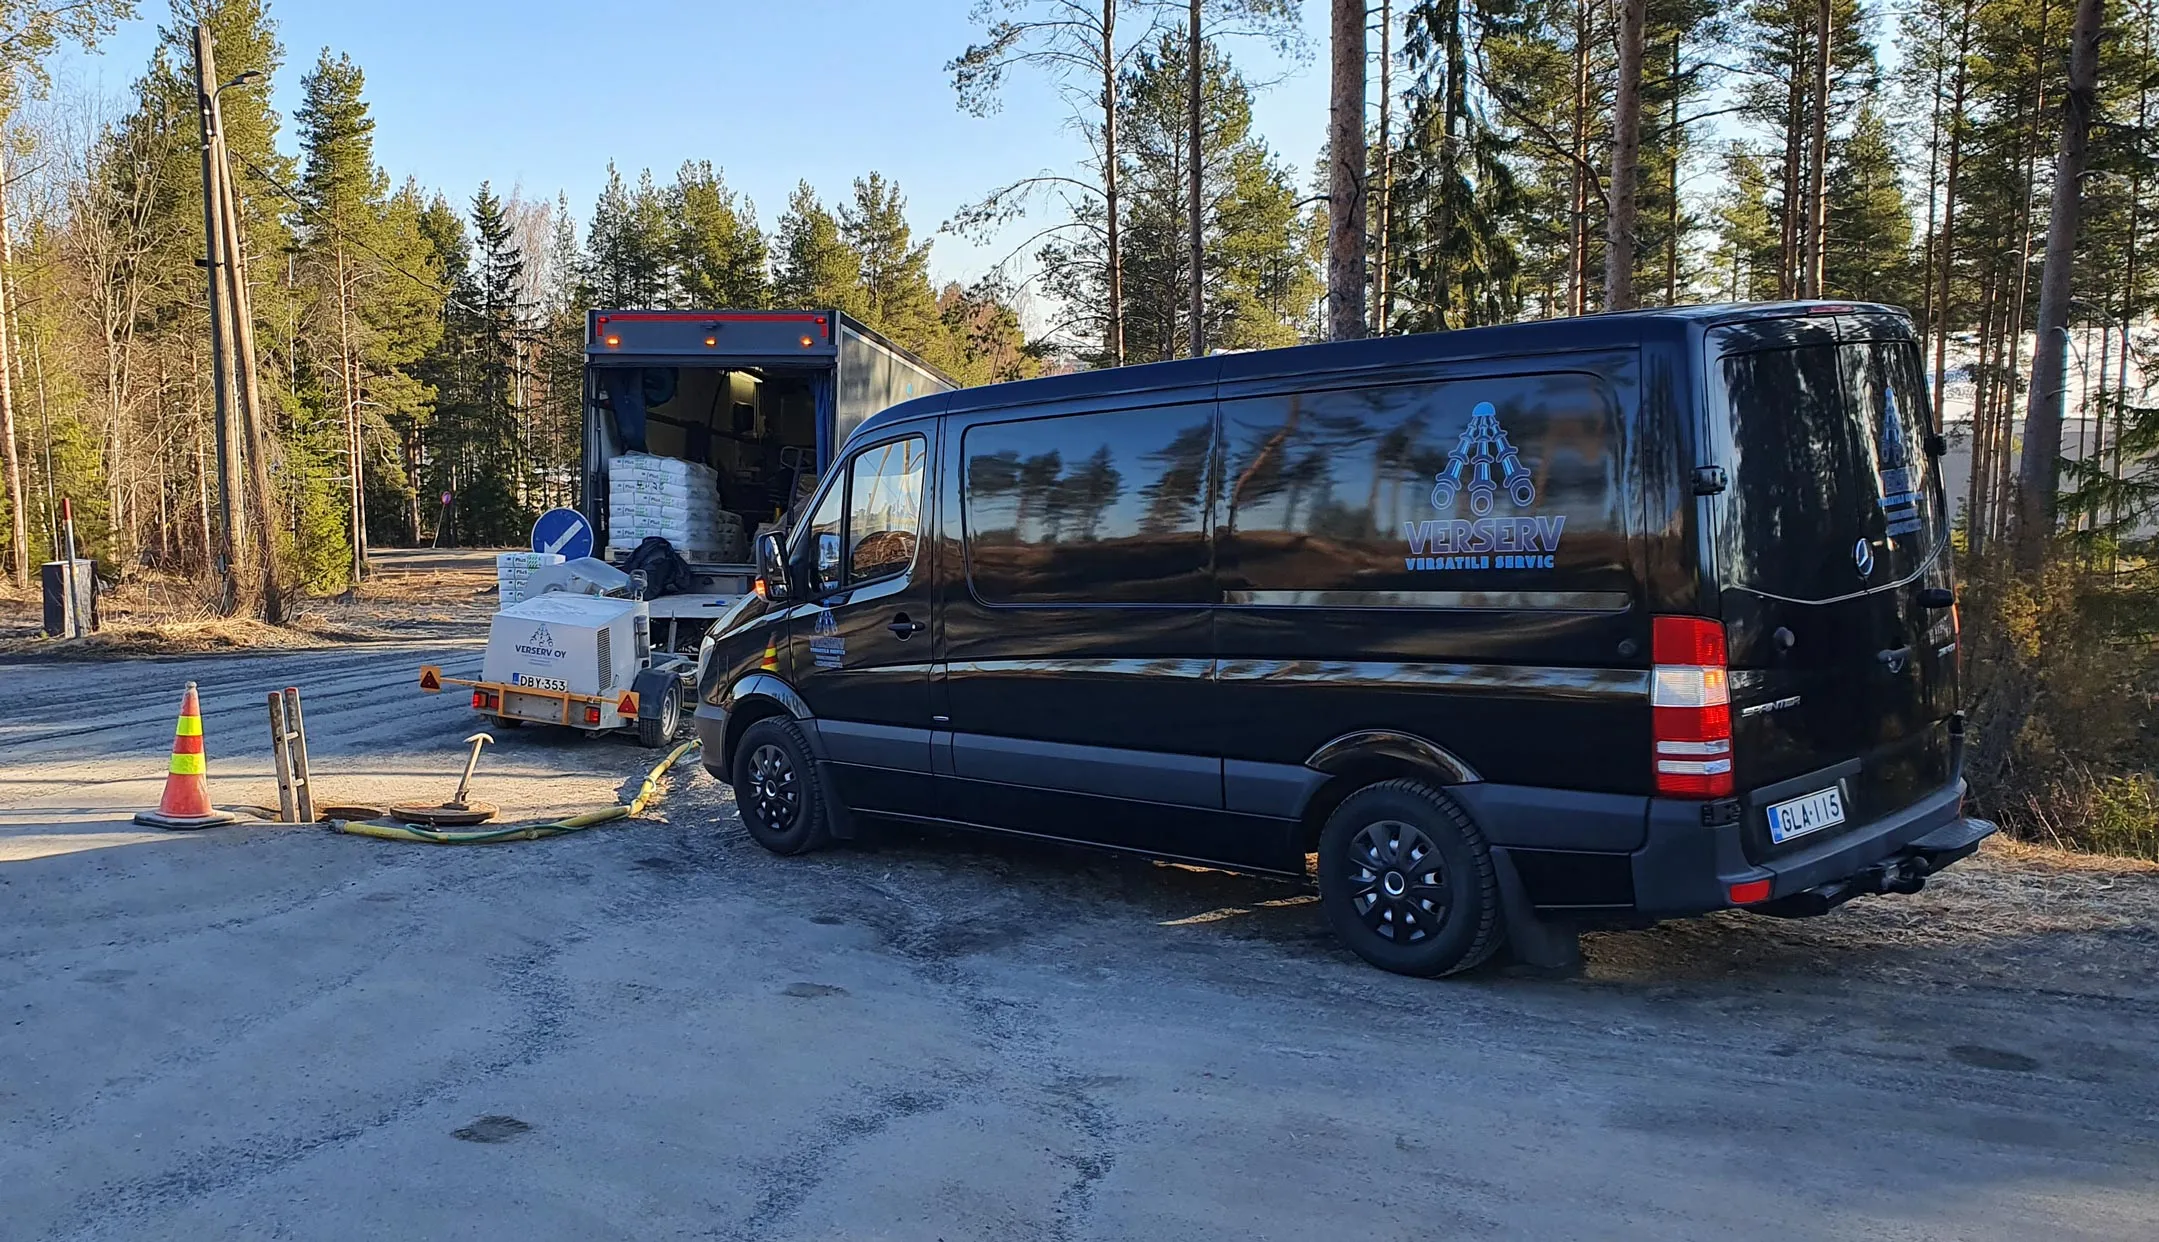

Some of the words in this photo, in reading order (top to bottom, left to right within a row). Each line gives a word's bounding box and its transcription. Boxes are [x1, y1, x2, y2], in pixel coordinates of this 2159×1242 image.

[1404, 516, 1566, 554] VERSERV
[1405, 556, 1489, 570] VERSATILE
[1495, 555, 1555, 569] SERVIC
[515, 644, 553, 657] VERSERV
[554, 650, 567, 659] OY
[520, 675, 566, 691] DBY-353
[1741, 695, 1801, 718] SPRINTER
[1781, 793, 1840, 833] GLA-115
